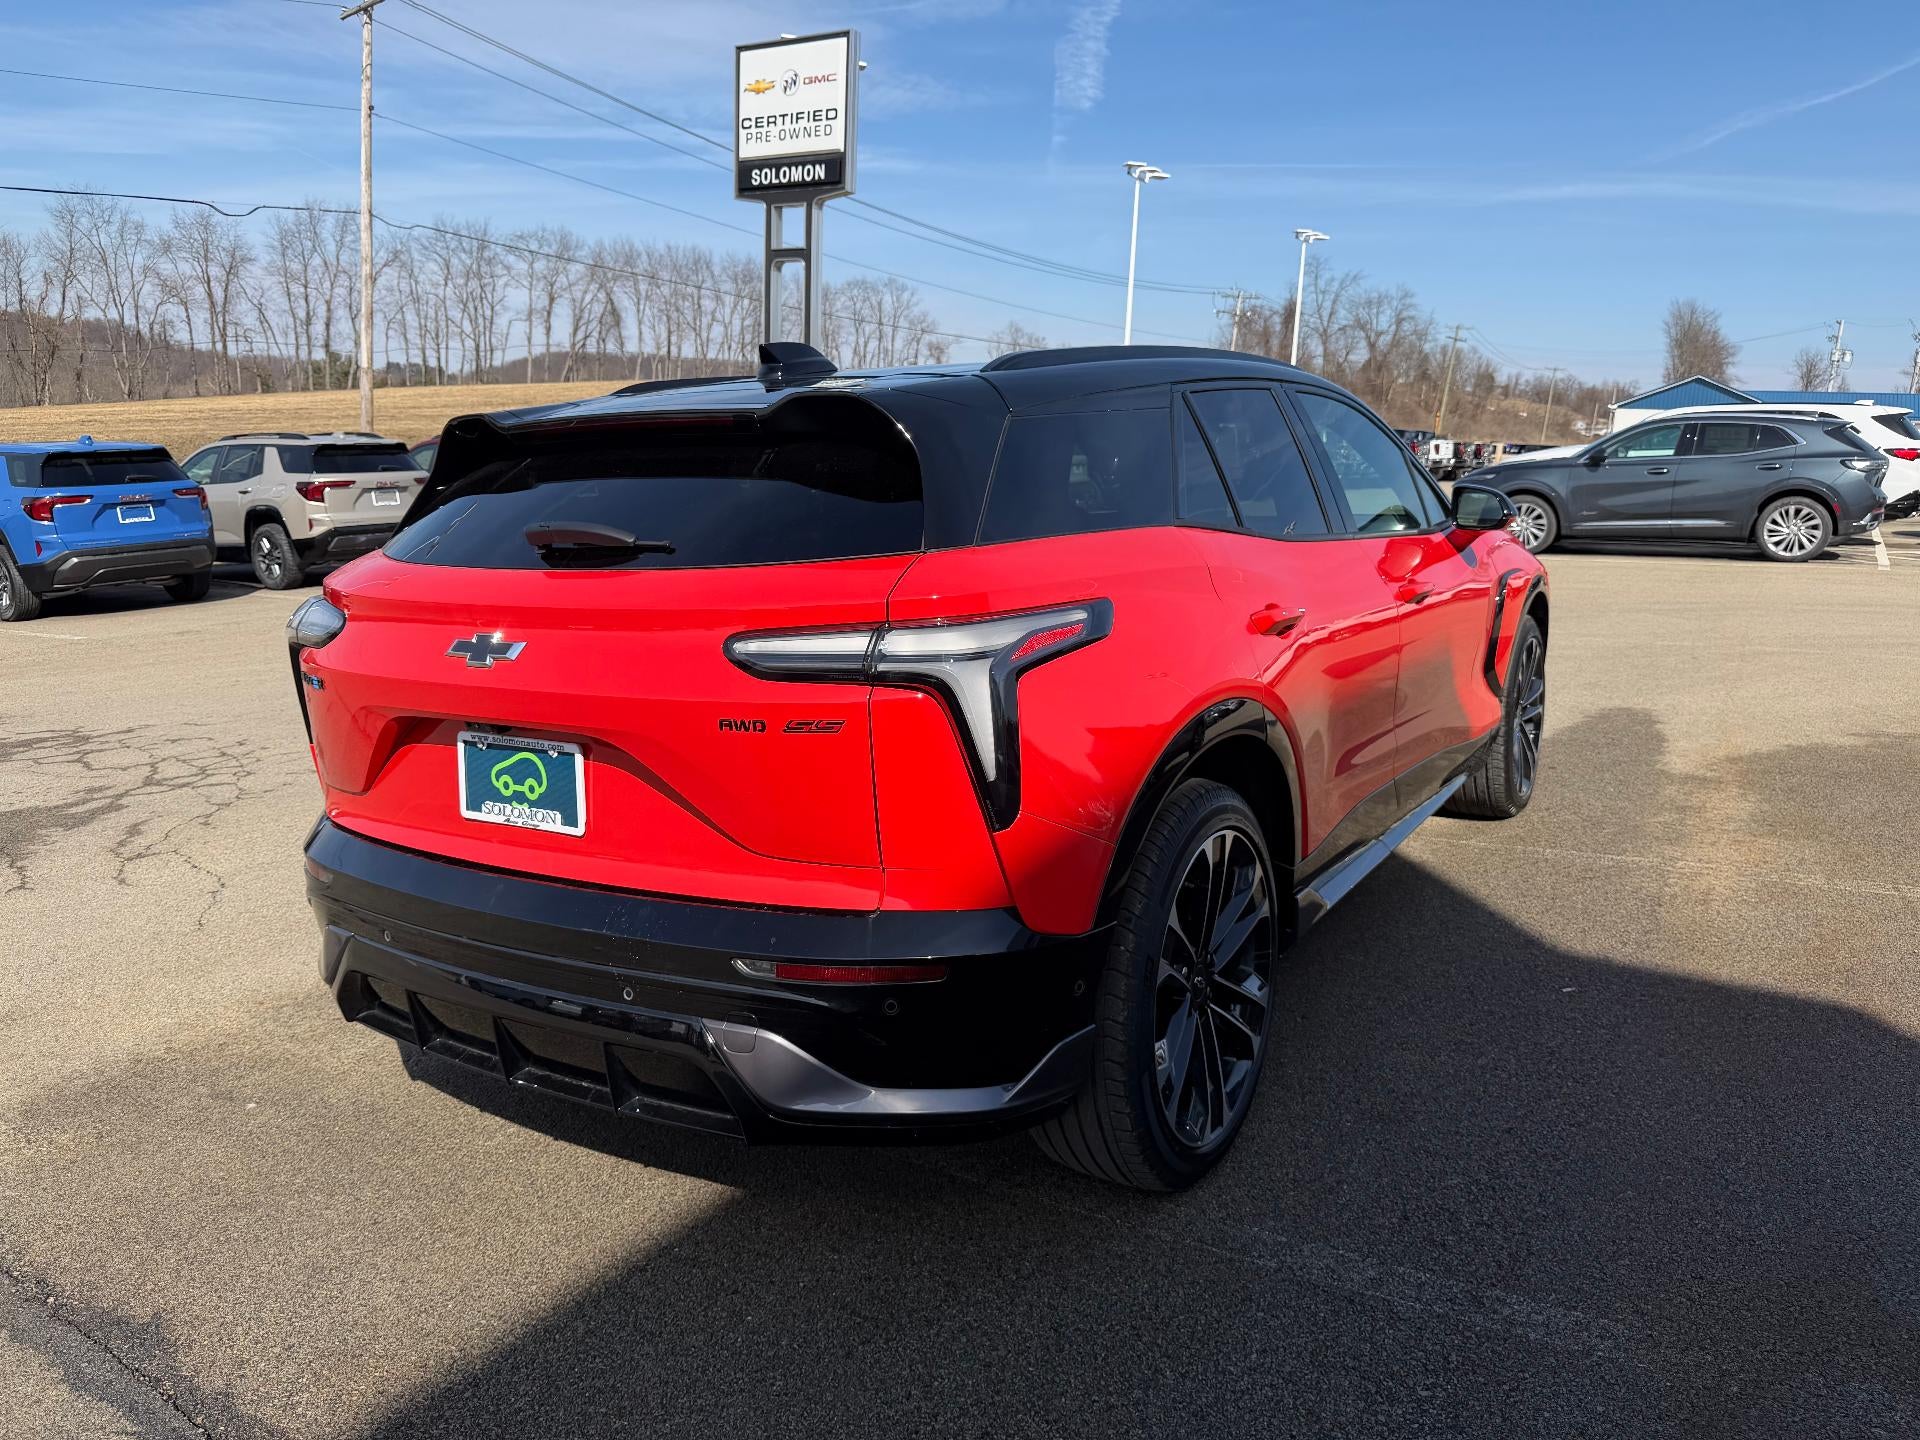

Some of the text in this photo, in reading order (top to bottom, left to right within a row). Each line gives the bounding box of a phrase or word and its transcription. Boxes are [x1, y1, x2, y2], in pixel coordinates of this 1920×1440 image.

[803, 73, 837, 85] GMC
[741, 108, 838, 130] CERTIFIED
[745, 124, 832, 144] PRE-OWNED
[751, 164, 826, 186] SOLOMON
[718, 718, 846, 734] AWD SS
[470, 733, 565, 751] www.solomonauto.com
[483, 802, 557, 825] SOLOMON
